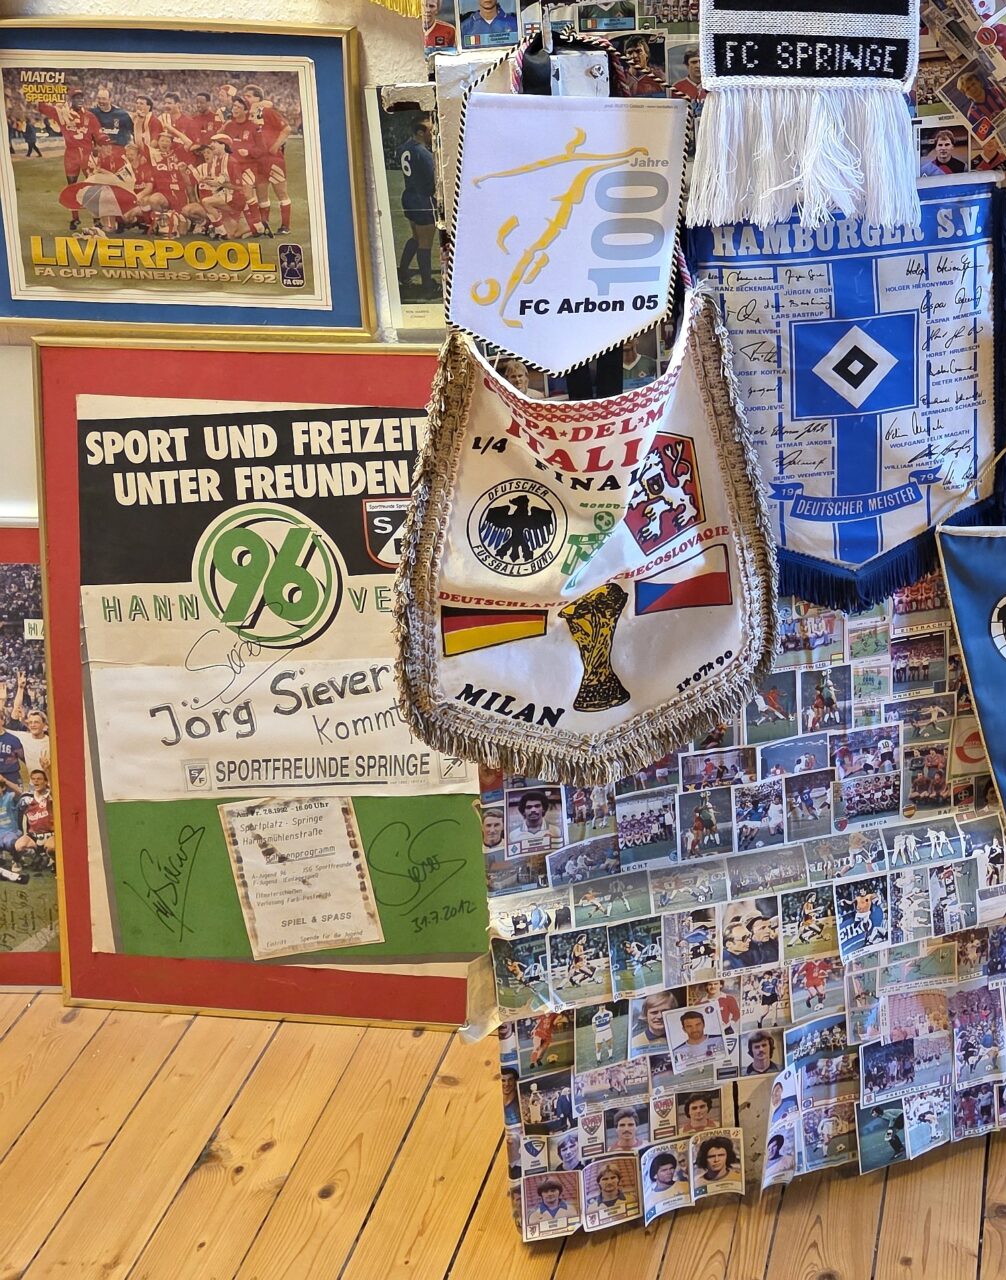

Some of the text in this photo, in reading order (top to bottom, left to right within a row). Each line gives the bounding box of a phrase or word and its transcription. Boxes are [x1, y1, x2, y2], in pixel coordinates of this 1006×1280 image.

[725, 42, 895, 75] FC SPRINGE
[20, 71, 65, 83] MATCH
[22, 84, 67, 94] SOUVENIR
[25, 93, 65, 104] SPECIAL!
[630, 157, 670, 168] Jahre
[587, 170, 669, 296] 100
[711, 206, 983, 258] HAMBURGER S.V.
[30, 236, 277, 272] LIVERPOOL
[35, 266, 277, 285] FA CUP WINNERS 1991/92
[885, 280, 954, 293] HOLGER HIERONYMUS
[735, 284, 784, 293] BECKENBAUER
[519, 294, 659, 315] FC Arbon 05
[790, 311, 824, 319] BASTRUP
[931, 373, 979, 387] DIETER KRAMER
[85, 417, 428, 465] SPORT UND FREIZEIT
[112, 460, 410, 506] UNTER FREUNDEN
[919, 473, 934, 482] 79
[795, 488, 915, 518] DEUTSCHER MEISTER
[471, 543, 555, 576] FUSSBALL-BUND
[213, 527, 319, 623] 96
[102, 592, 200, 622] HANN
[438, 590, 568, 608] DEUTSCHLAND
[150, 690, 257, 746] Jörg
[454, 683, 564, 728] MILAN
[216, 753, 431, 783] SPORTFREUNDE SPRINGE
[281, 918, 307, 928] SPIEL
[321, 913, 352, 923] SPASS
